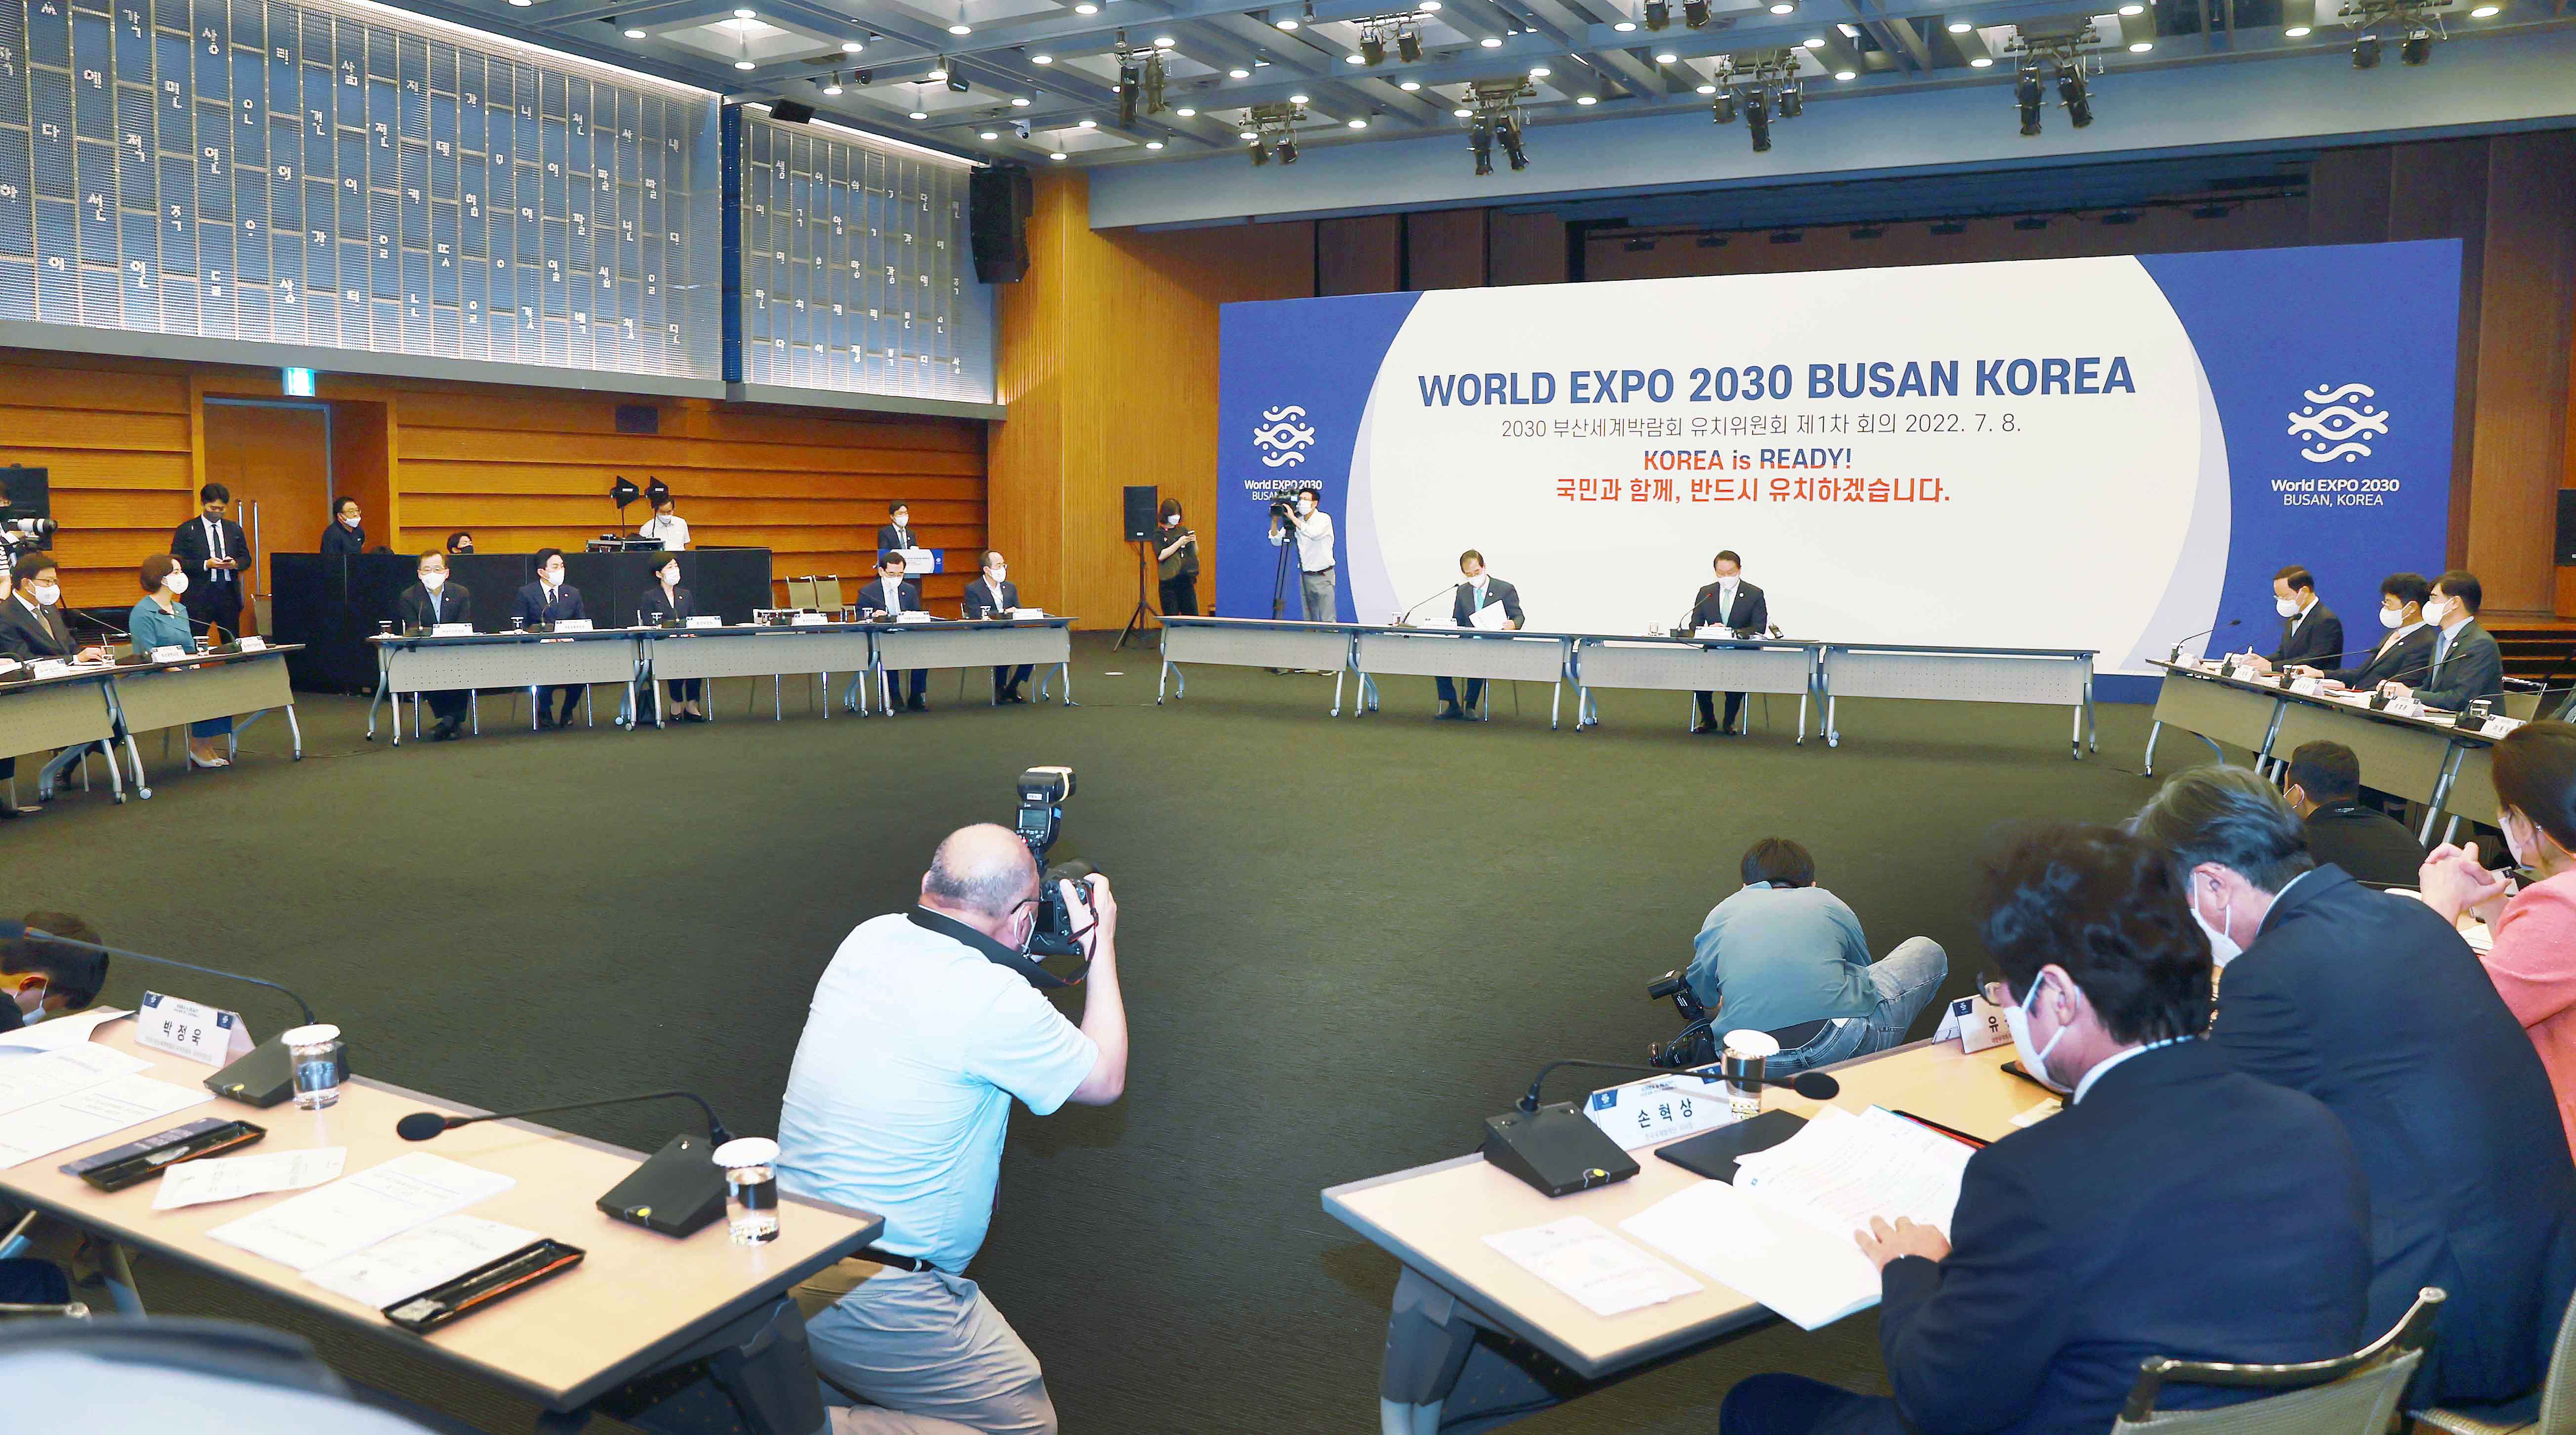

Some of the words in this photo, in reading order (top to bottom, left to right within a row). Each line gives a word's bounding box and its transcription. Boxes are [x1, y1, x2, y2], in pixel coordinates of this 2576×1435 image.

[202, 27, 219, 55] 상
[341, 60, 359, 87] 삼
[1418, 372, 1556, 407] WORLD
[1570, 368, 1674, 404] EXPO
[1689, 364, 1793, 402] 2030
[1808, 360, 1959, 399] BUSAN
[1975, 356, 2136, 396] KOREA
[1502, 420, 1547, 437] 2030
[1553, 417, 1682, 438] 부산세계박람회
[1690, 414, 1787, 437] 유치위원회
[1796, 413, 1850, 435] 제1차
[1857, 413, 1896, 434] 회의
[1905, 413, 1965, 433] 2022.
[1975, 413, 1993, 432] 7.
[2002, 413, 2021, 432] 8.
[1644, 450, 1724, 471] KOREA
[1732, 449, 1751, 470] is
[1760, 448, 1852, 470] READY!
[1244, 479, 1270, 490] World
[1272, 480, 1298, 490] EXPO
[1299, 480, 1323, 490] 2030
[1557, 478, 1622, 502] 국민과
[1630, 478, 1681, 504] 함께,
[1691, 478, 1759, 502] 반드시
[1769, 477, 1950, 503] 유치하겠습니다.
[2271, 478, 2315, 492] World
[2318, 479, 2359, 492] EXPO
[2361, 479, 2400, 492] 2030
[2283, 493, 2333, 507] BUSAN,
[2337, 494, 2384, 506] KOREA
